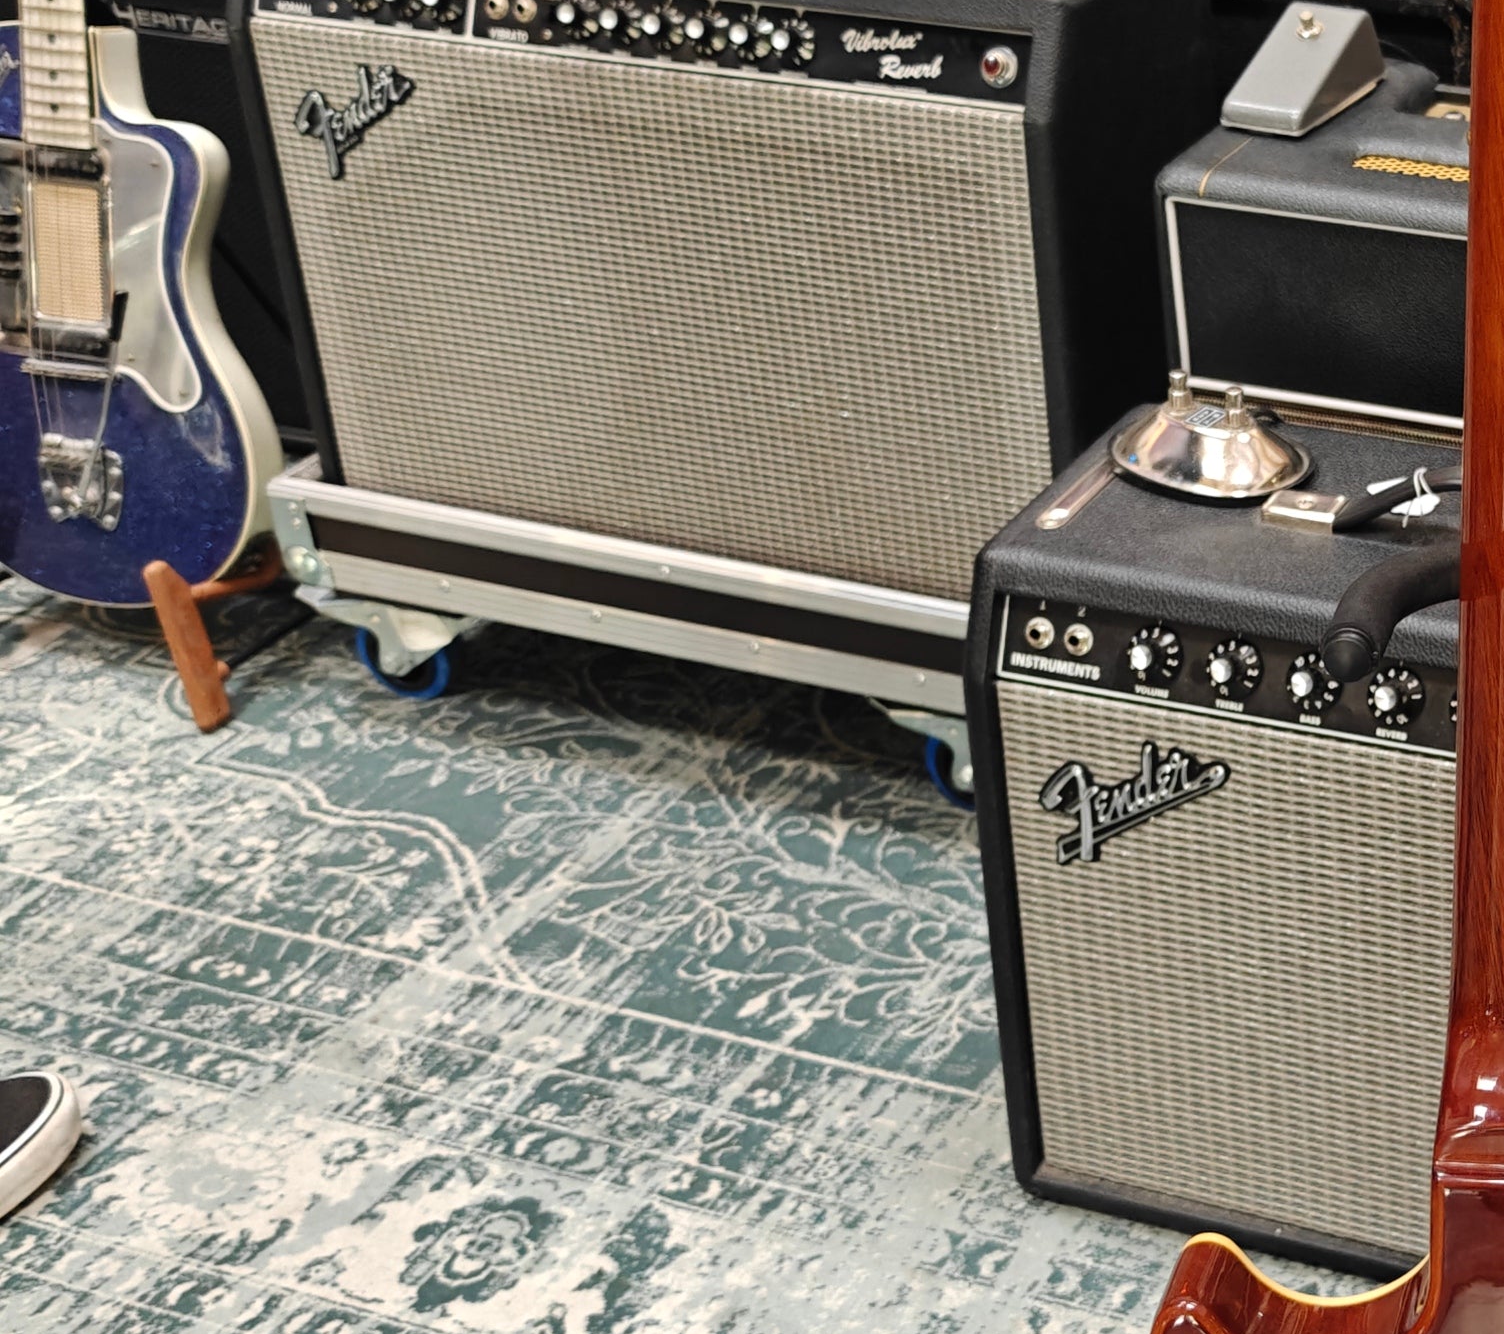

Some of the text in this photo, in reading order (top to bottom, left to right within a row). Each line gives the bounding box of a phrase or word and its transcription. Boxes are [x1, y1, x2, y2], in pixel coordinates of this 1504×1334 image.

[110, 0, 232, 44] HERITAG
[488, 27, 529, 44] VIBRATO
[841, 27, 918, 53] Vibrolux
[878, 54, 944, 80] Reverb
[295, 66, 412, 179] Fender
[1010, 652, 1101, 681] INSTRUMENTS
[1134, 683, 1169, 699] VOLUME
[1215, 698, 1245, 712] TREBLE
[1299, 713, 1322, 726] BASS
[1375, 727, 1408, 742] REVERB
[1041, 743, 1226, 865] Fender
